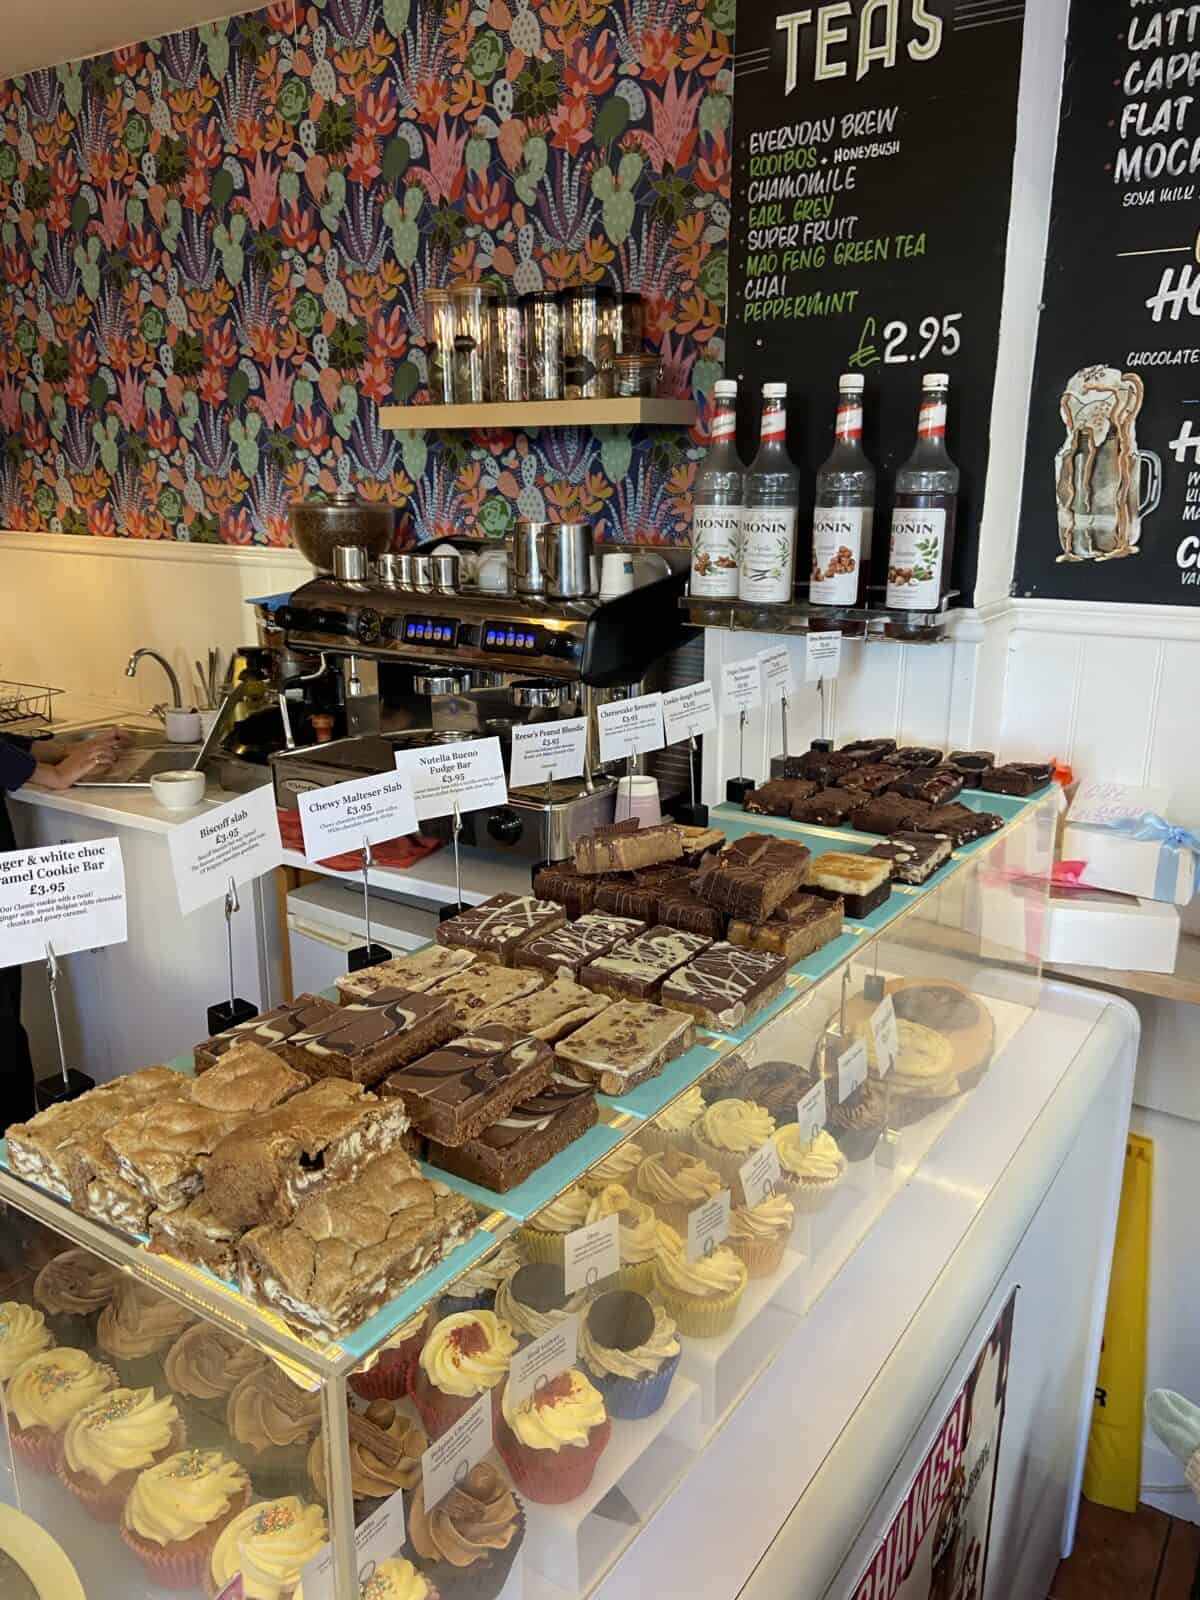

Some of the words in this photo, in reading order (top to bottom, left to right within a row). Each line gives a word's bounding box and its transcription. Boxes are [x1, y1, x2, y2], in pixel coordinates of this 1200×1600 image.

[776, 0, 943, 96] TEAS
[1121, 96, 1194, 139] FLAT
[750, 116, 836, 154] EVERYDAY
[840, 106, 899, 139] BREW
[750, 147, 817, 177] ROOIBOS
[833, 140, 900, 164] HONEYBUSH
[748, 166, 857, 204] CHAMOMILE
[1122, 189, 1156, 207] SOYA
[1160, 185, 1195, 202] MILK
[749, 203, 786, 229] EARL
[792, 195, 835, 223] GREY
[748, 224, 800, 251] SUPER
[803, 216, 859, 250] FRUIT
[746, 254, 778, 277] MAO
[782, 246, 826, 273] FENG
[833, 238, 890, 266] GREEN
[896, 232, 927, 259] TEA
[744, 276, 787, 300] CHAI
[744, 290, 860, 324] PEPPERMINT
[849, 313, 963, 367] £2.95
[1126, 349, 1200, 366] CHOCOLATE
[696, 519, 738, 529] MONIN
[815, 522, 852, 533] ONIN
[419, 753, 450, 766] Nutella
[452, 750, 478, 760] Bueno
[430, 763, 455, 775] Fudge
[457, 761, 472, 769] Bar
[442, 773, 465, 783] £3.95
[308, 799, 341, 813] Chewy
[342, 789, 382, 804] Malteser
[383, 782, 402, 794] Slab
[346, 802, 373, 816] £3.95
[199, 816, 230, 839] Biscoff
[231, 809, 248, 824] slab
[215, 828, 239, 845] £3.95
[27, 855, 37, 866] &
[40, 850, 76, 864] white
[78, 846, 105, 858] choc
[37, 864, 80, 879] Cookie
[83, 860, 105, 872] Bar
[30, 882, 65, 896] £3.95
